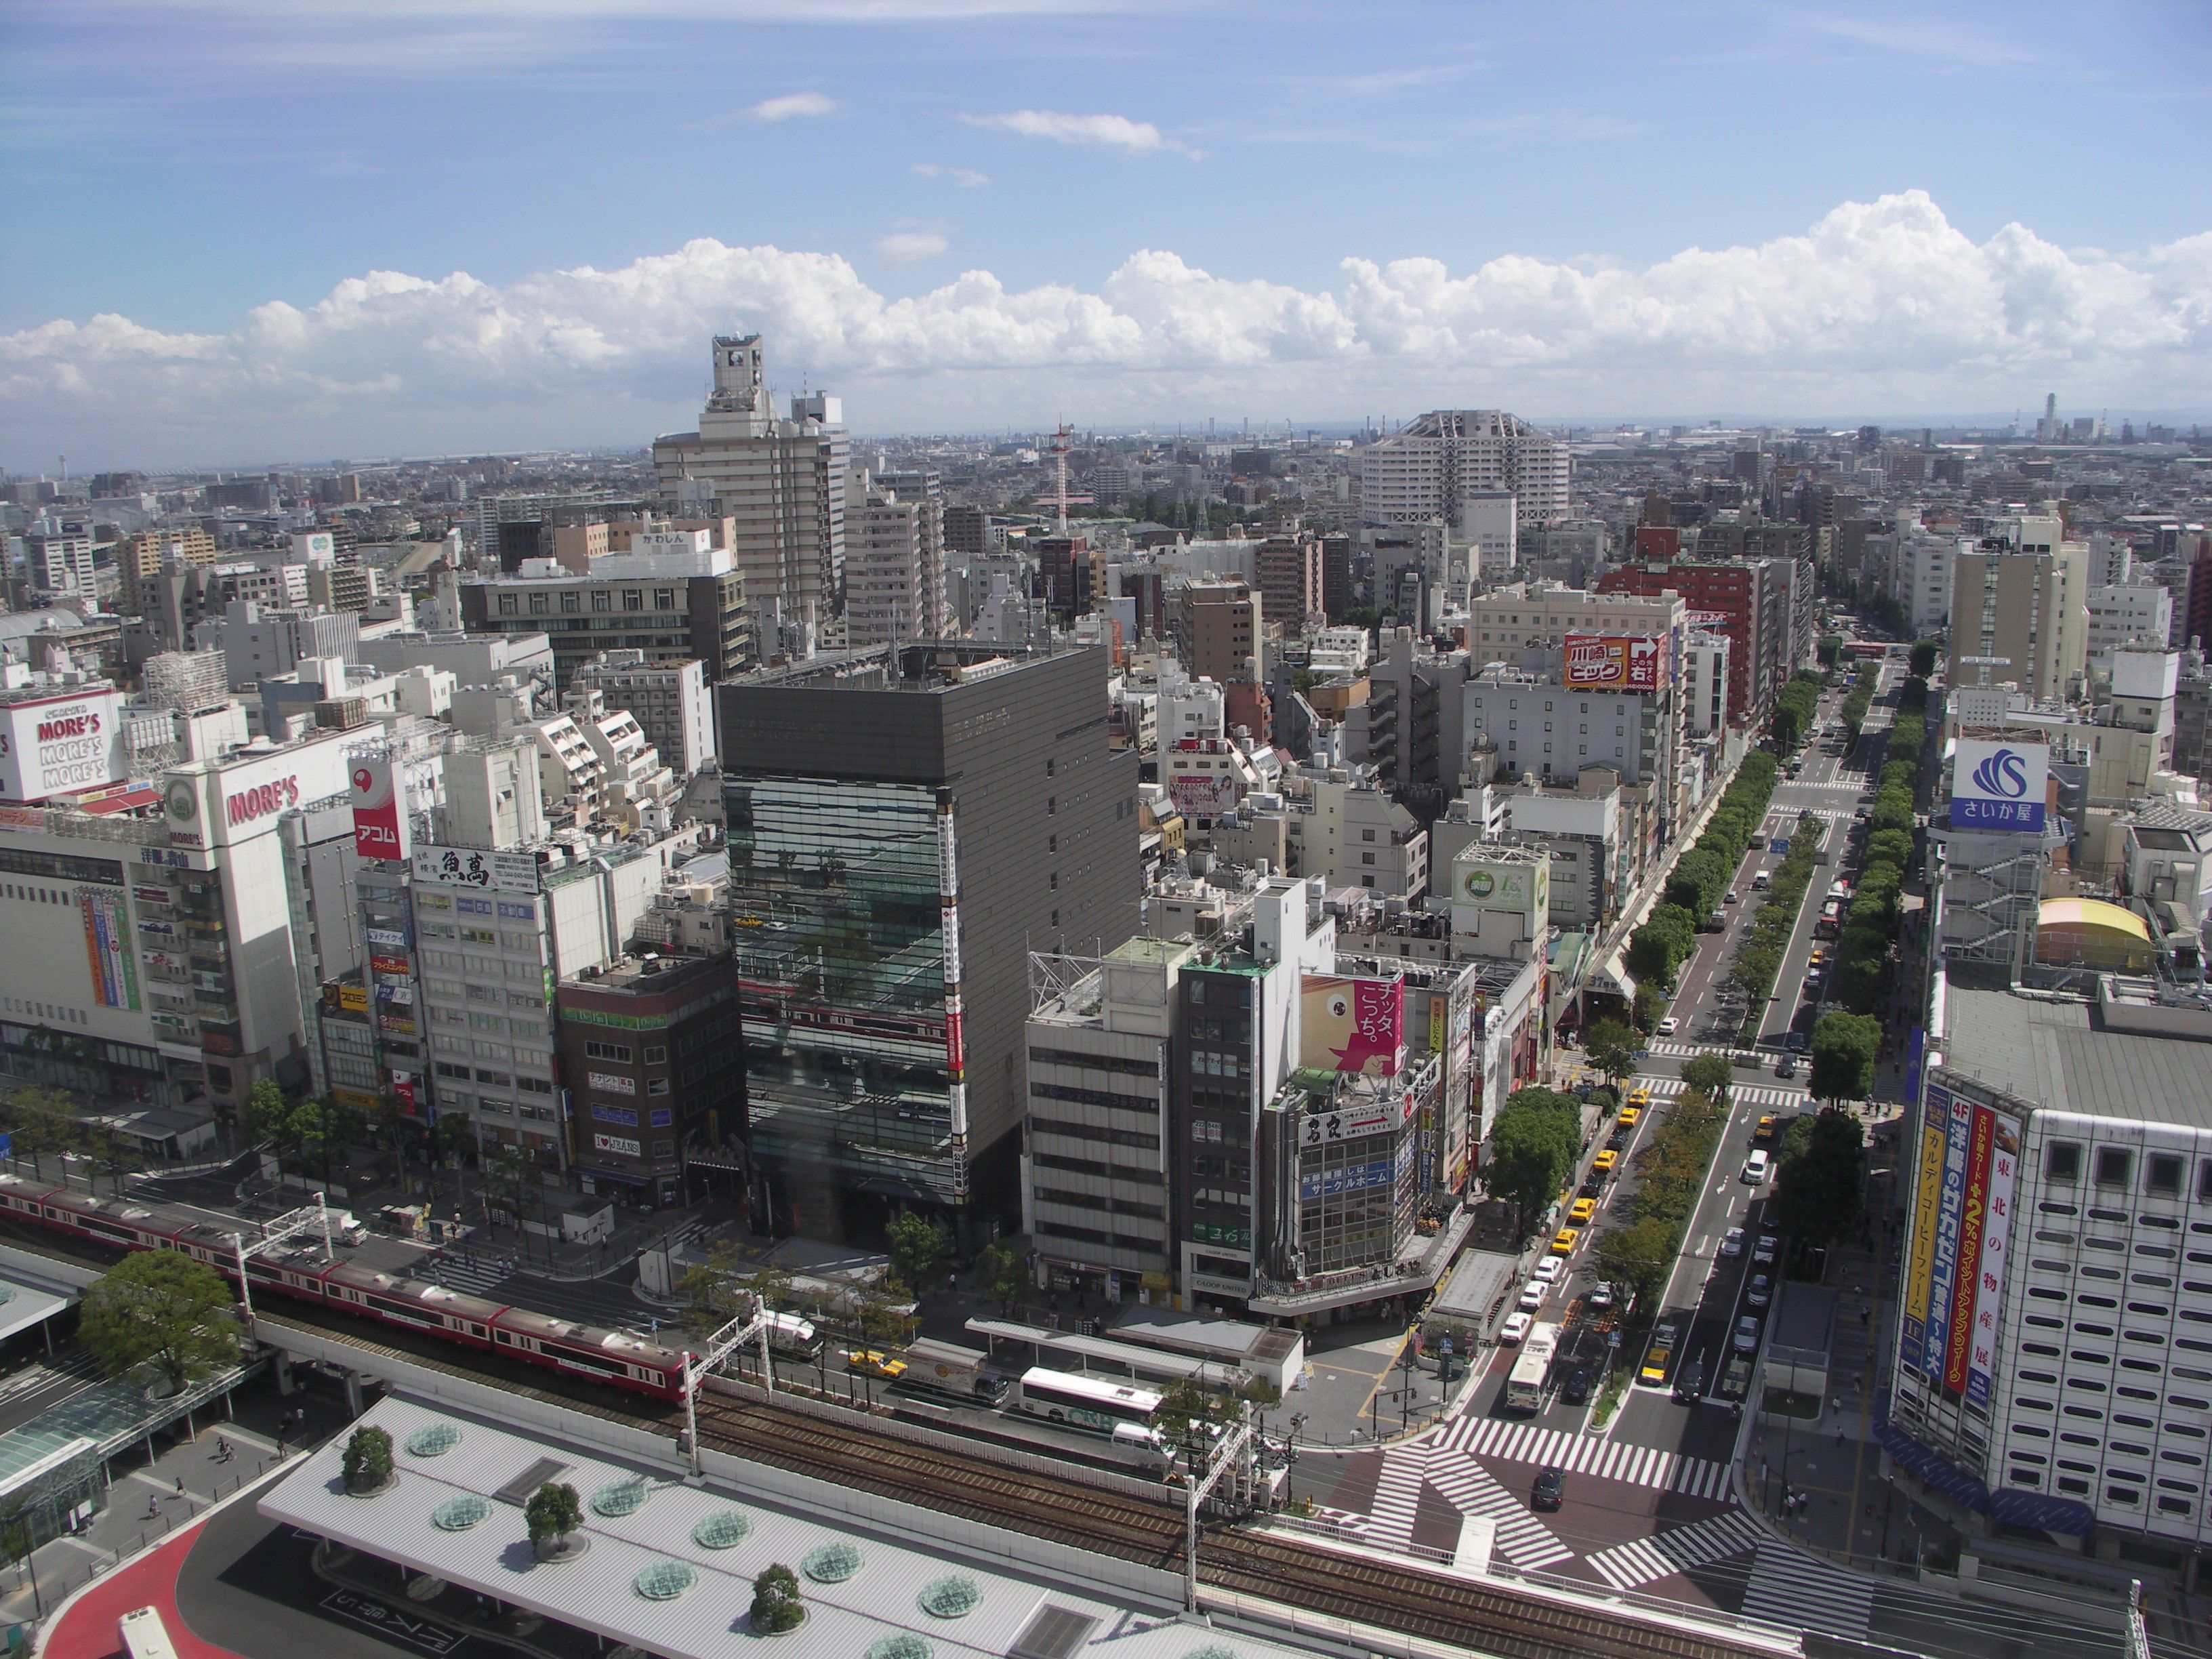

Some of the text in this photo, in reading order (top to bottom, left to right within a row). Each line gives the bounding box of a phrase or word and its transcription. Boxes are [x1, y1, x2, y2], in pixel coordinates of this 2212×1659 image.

[1570, 644, 1607, 662] 川崎
[1569, 661, 1622, 682] ビッグ
[1630, 665, 1647, 682] 右
[37, 714, 101, 743] MORE'S
[40, 736, 103, 766] MORE'S
[43, 758, 106, 790] MORE'S
[228, 775, 299, 827] MORE'S
[1965, 800, 2032, 822] さいか屋
[171, 832, 202, 845] MORE'S
[357, 824, 397, 844] アコム
[1360, 985, 1378, 1043] こっち。
[1952, 1101, 1969, 1120] 4F
[596, 1136, 638, 1153] I JEANS
[1302, 1165, 1365, 1185] お部屋探しは
[1311, 1172, 1387, 1195] サークルホーム
[1911, 1133, 1940, 1313] カルディコーヒーファーム
[1974, 1158, 2010, 1367] 東北の物産展
